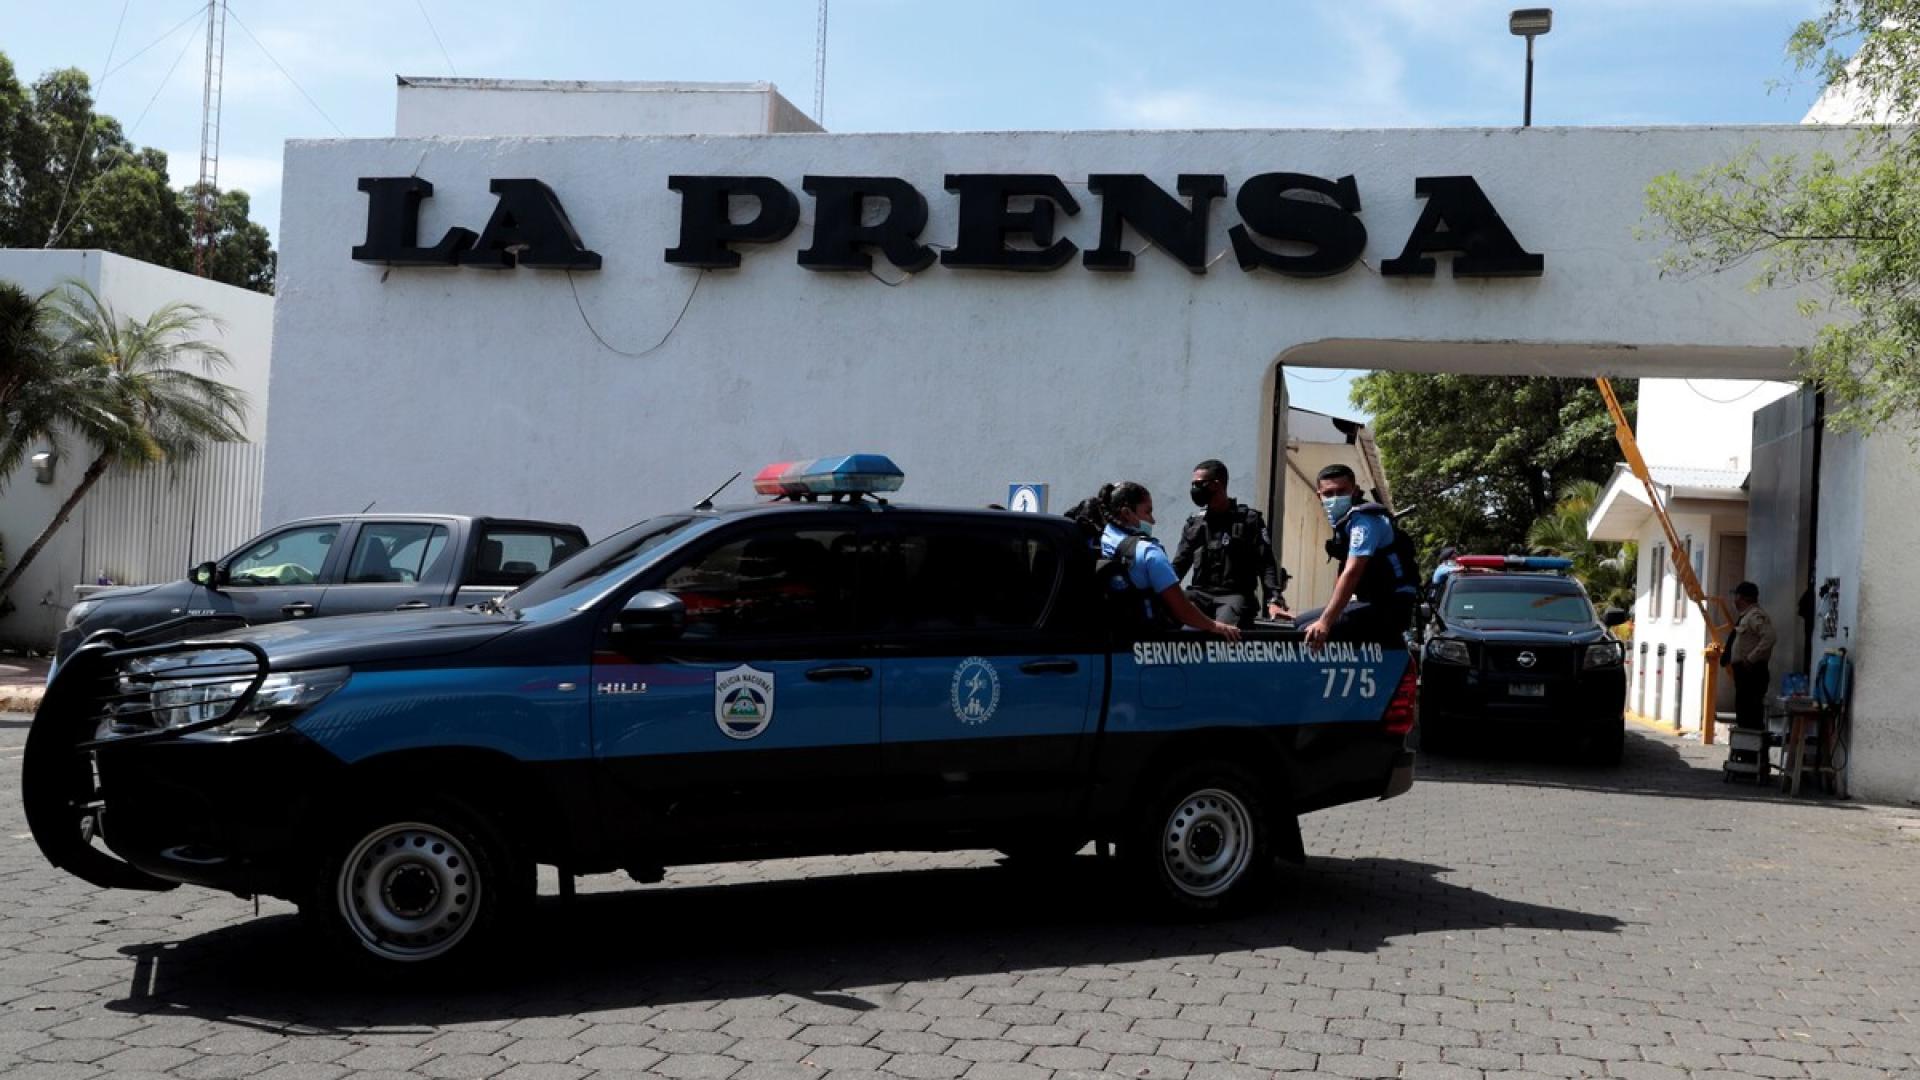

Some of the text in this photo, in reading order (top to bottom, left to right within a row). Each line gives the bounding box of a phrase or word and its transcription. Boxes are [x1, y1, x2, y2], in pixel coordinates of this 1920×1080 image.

[352, 171, 1544, 279] LA PRENSA
[1133, 641, 1203, 665] SERVICIO
[1207, 641, 1297, 663] EMERGENCIA
[1360, 643, 1383, 663] 118
[1321, 668, 1376, 698] 775
